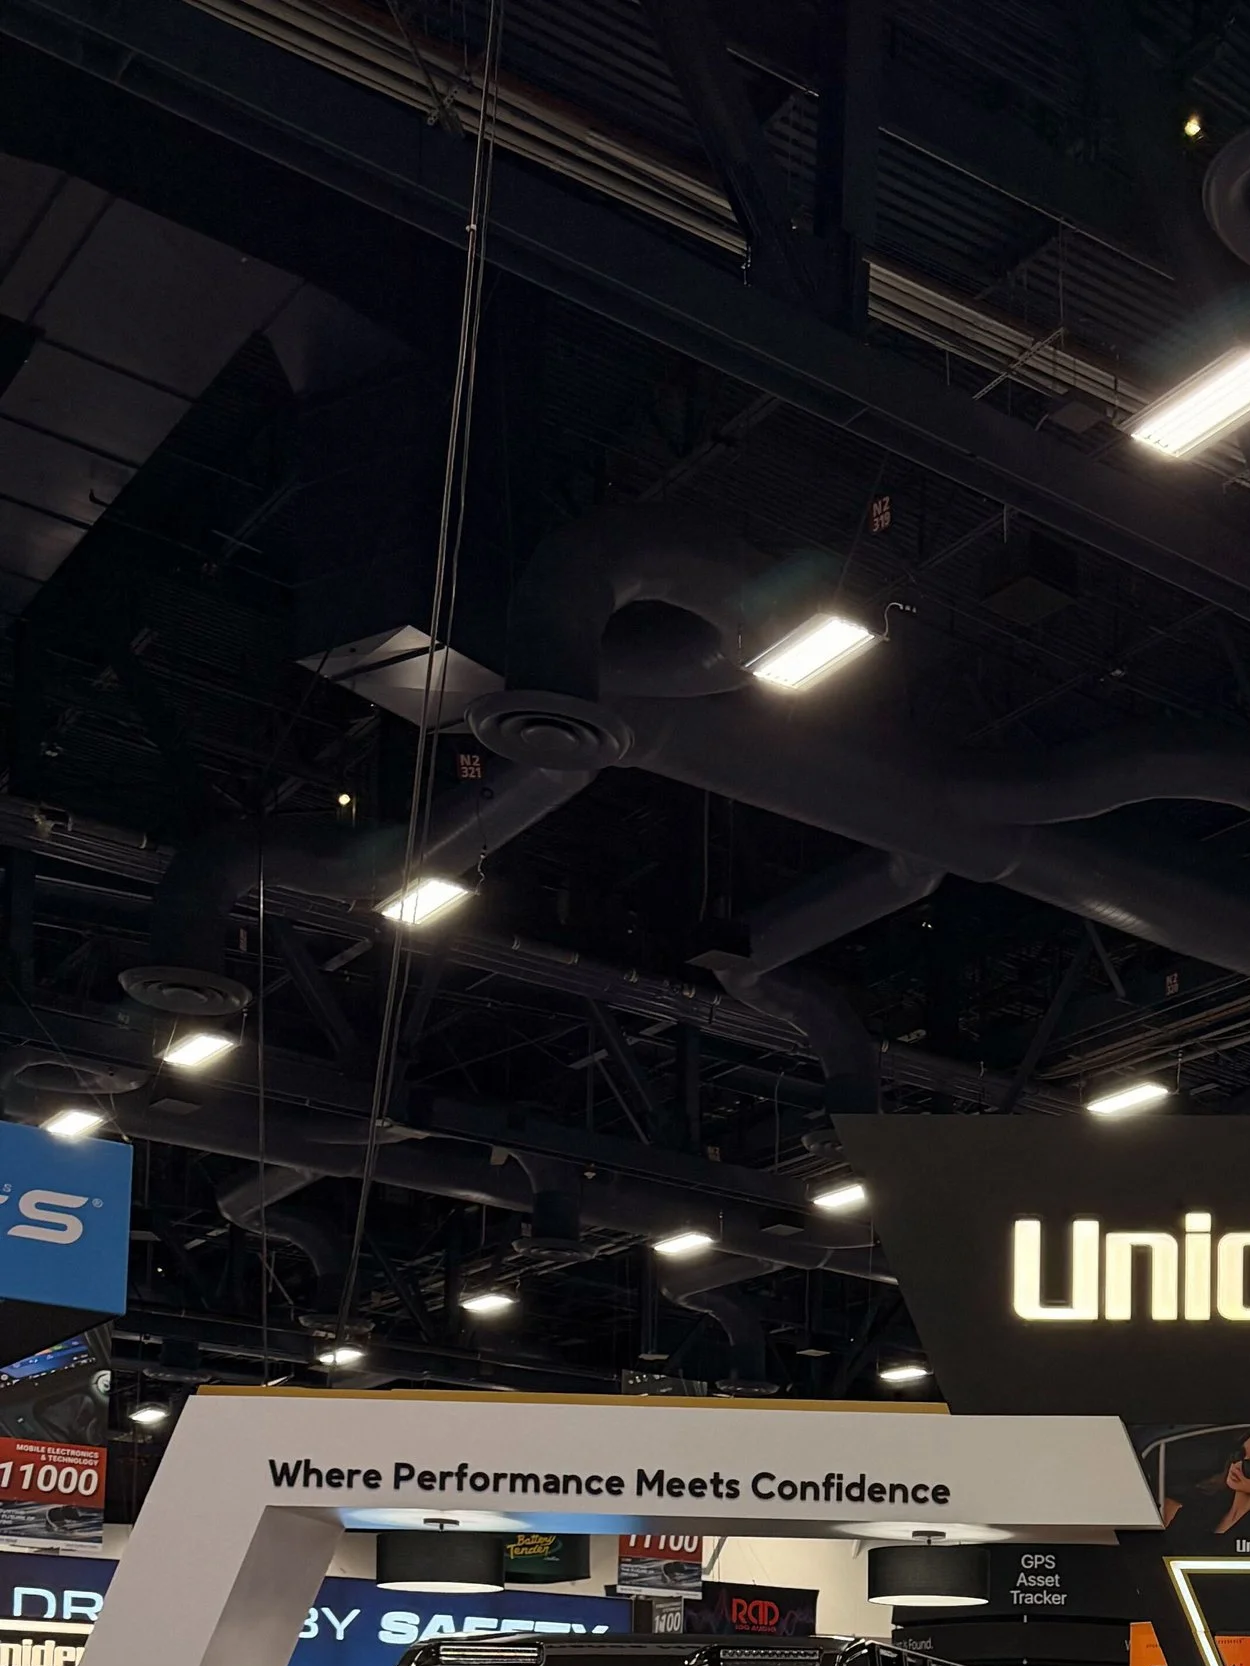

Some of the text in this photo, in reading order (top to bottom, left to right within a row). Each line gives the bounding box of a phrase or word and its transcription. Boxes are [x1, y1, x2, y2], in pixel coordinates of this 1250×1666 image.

[460, 754, 481, 766] N2
[461, 767, 482, 778] 321
[0, 1190, 104, 1245] S®
[16, 1443, 99, 1459] MOBILE ELECTRONICS
[48, 1454, 99, 1466] TECHNOLOGY
[0, 1461, 99, 1496] 11000
[268, 1459, 952, 1505] Where Performance Meets Confidence
[517, 1534, 556, 1545] Battery
[506, 1543, 550, 1560] Tender
[1020, 1554, 1056, 1570] GPS
[1016, 1572, 1061, 1588] Asset
[1010, 1590, 1067, 1606] Tracker
